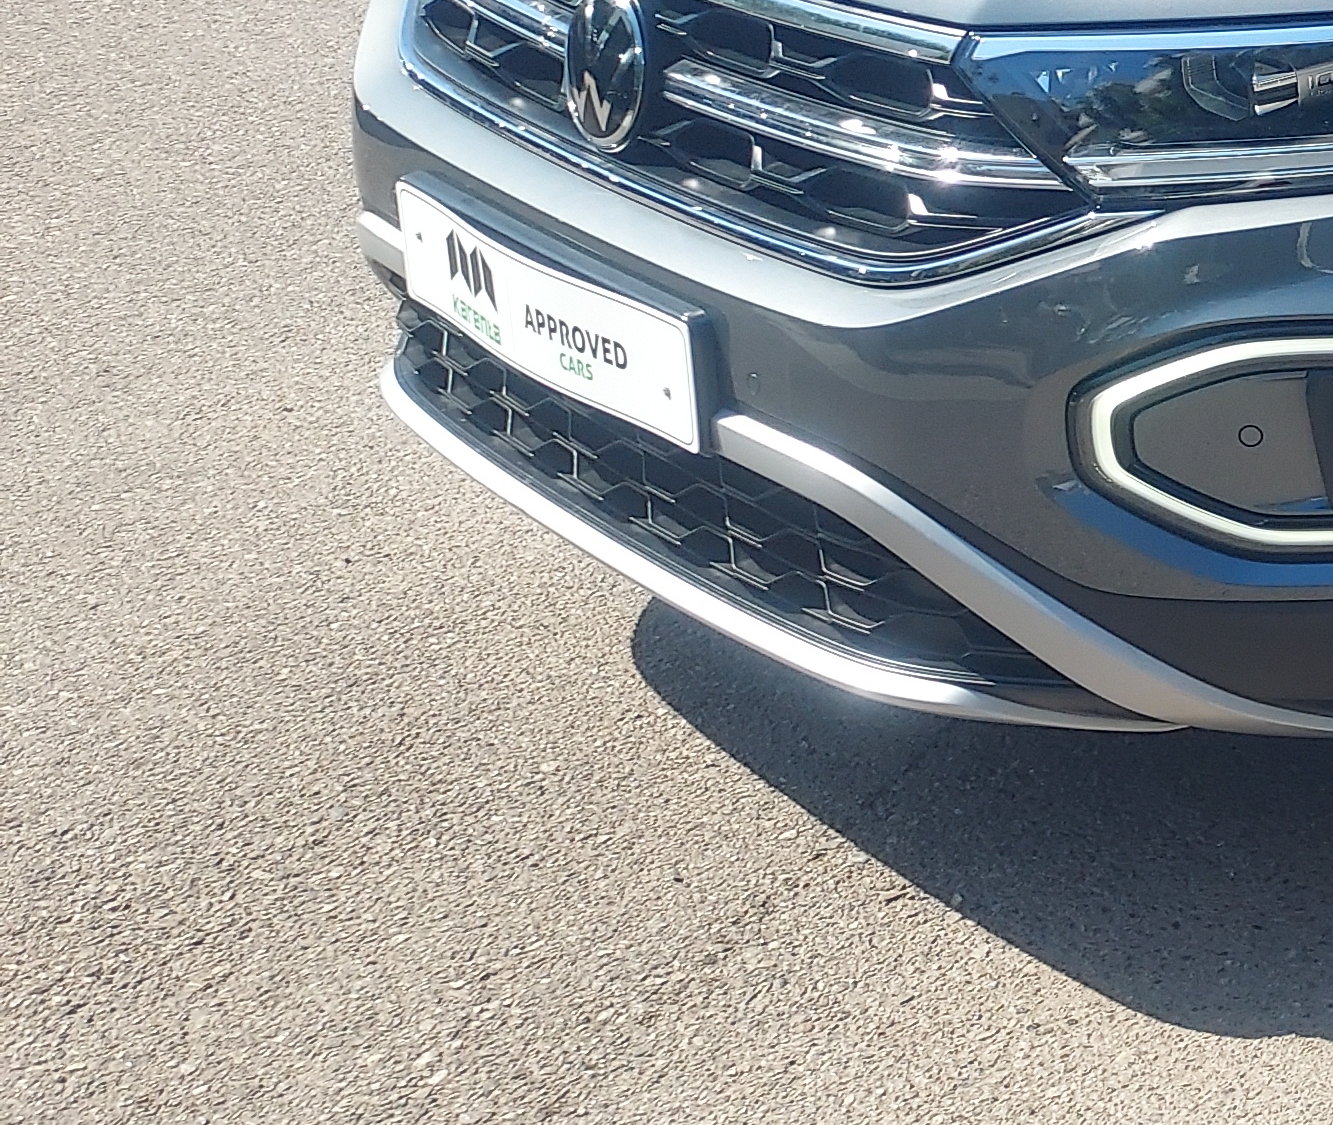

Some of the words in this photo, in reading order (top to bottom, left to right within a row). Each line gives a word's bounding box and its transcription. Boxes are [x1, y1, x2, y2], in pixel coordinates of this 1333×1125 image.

[452, 293, 502, 346] karenta
[524, 303, 628, 370] APPROVED
[559, 352, 593, 381] CARS
